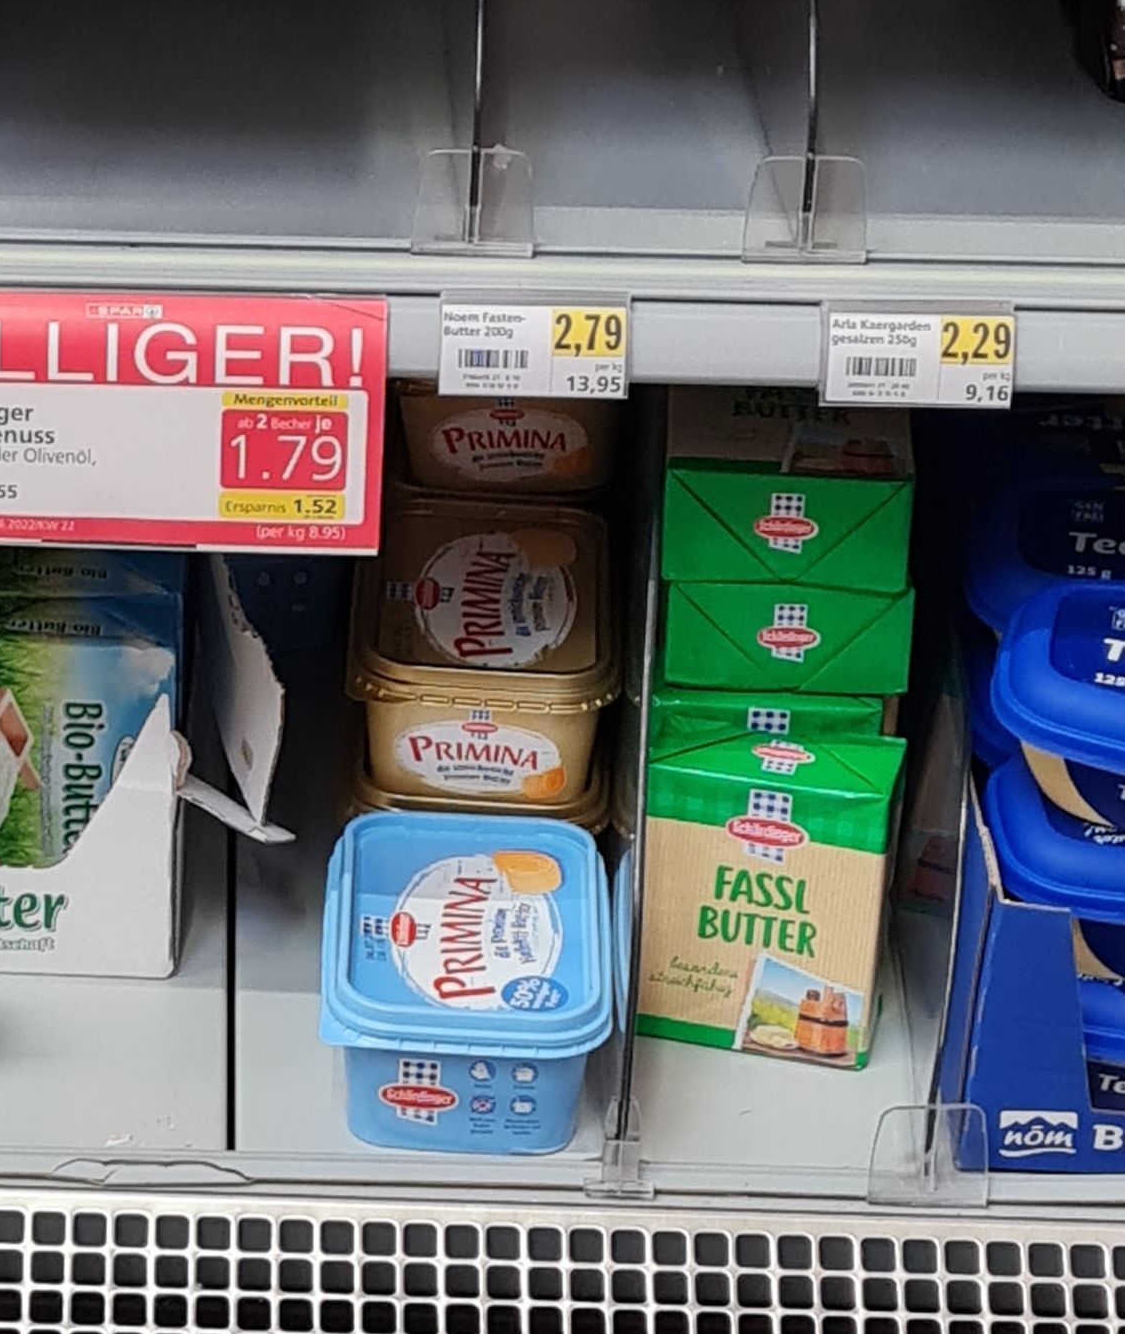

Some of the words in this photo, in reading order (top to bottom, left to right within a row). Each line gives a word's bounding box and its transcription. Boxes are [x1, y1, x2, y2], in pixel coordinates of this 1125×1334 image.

[443, 313, 480, 323] Noem
[483, 313, 525, 323] Fasten-
[832, 318, 857, 330] Arla
[860, 319, 931, 333] Kaergarden
[443, 326, 478, 336] Butter
[481, 327, 513, 339] 200g
[555, 313, 622, 358] 2,79
[887, 333, 917, 347] 250g
[941, 321, 1012, 365] 2,29
[566, 376, 621, 393] 13,95
[965, 384, 1009, 403] 9,16
[234, 393, 338, 408] Mengenvorteil
[442, 427, 567, 455] PRIMINA
[23, 447, 97, 467] Olivenöl,
[228, 435, 342, 482] 1.79
[225, 500, 286, 516] Ersparnis
[294, 499, 336, 514] 1.52
[409, 736, 538, 768] PRIMINA
[714, 865, 811, 915] FASSL
[432, 876, 497, 1001] PRIMINA
[697, 906, 817, 958] BUTTER
